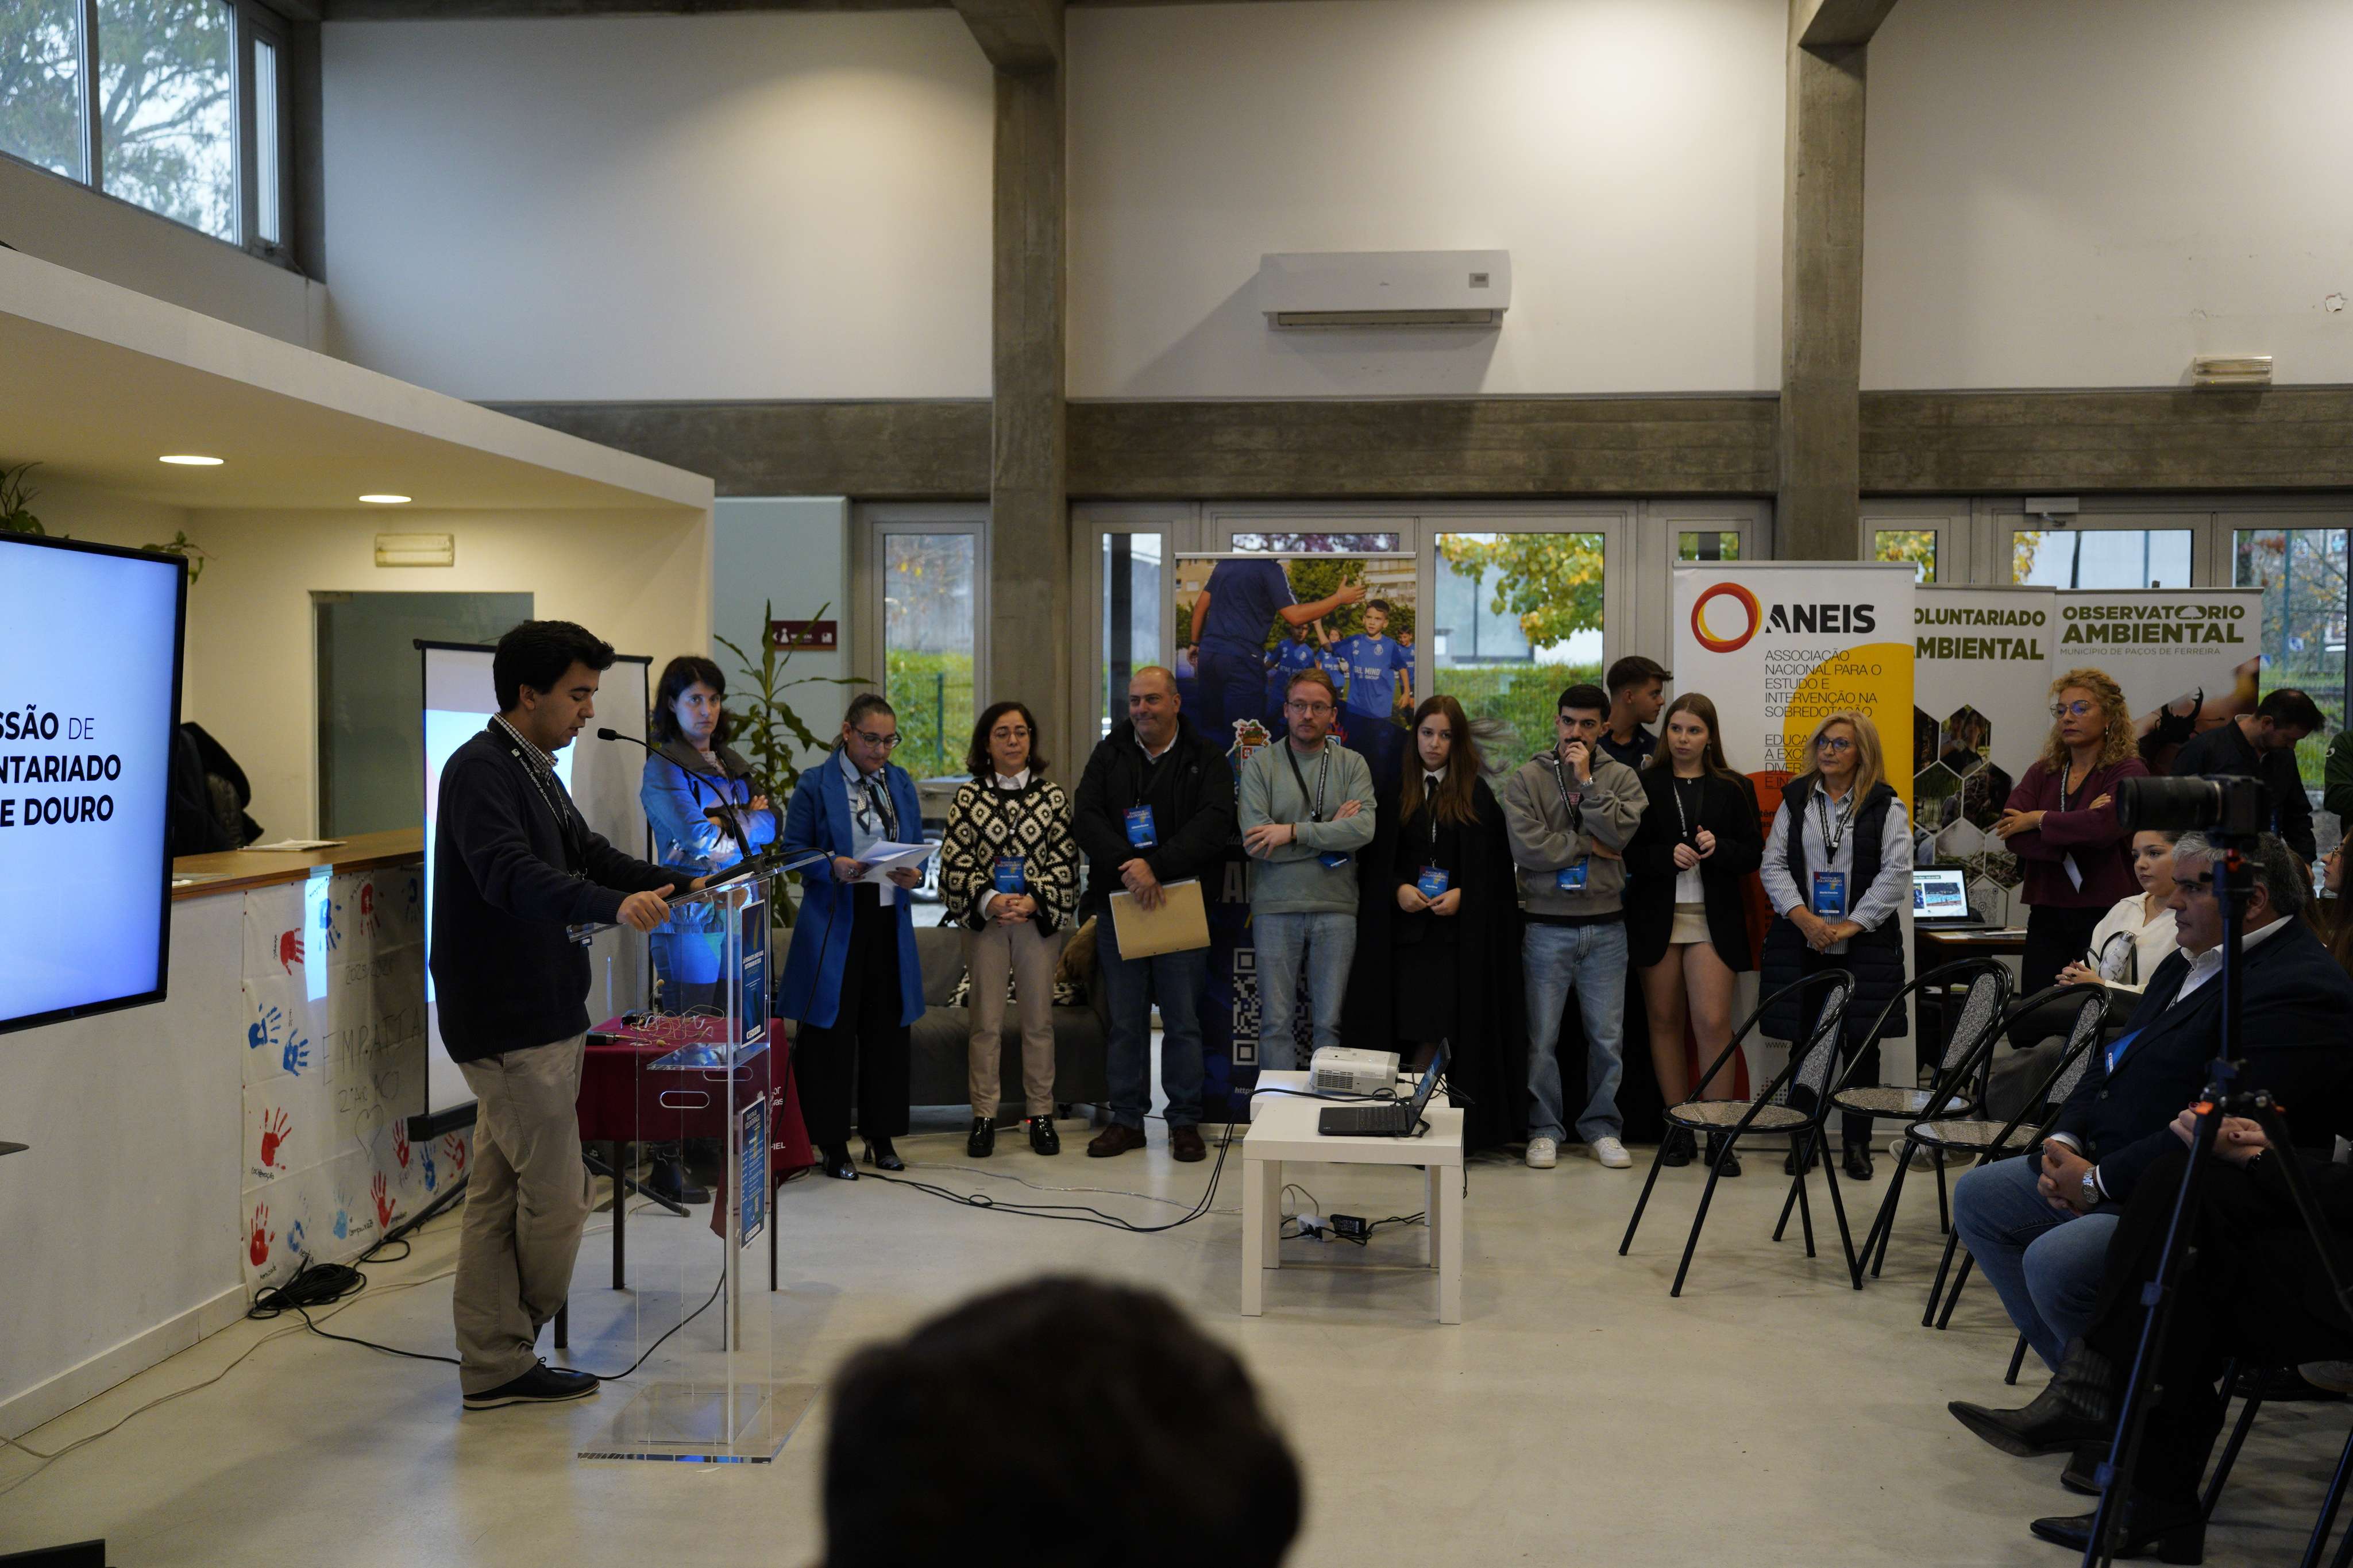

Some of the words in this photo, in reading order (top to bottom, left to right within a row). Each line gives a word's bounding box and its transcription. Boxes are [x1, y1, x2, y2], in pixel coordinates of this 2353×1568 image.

[1765, 604, 1876, 634] ANEIS
[2061, 623, 2244, 644] AMBIENTAL
[1765, 648, 1850, 664] ASSOCIAÇÃO
[1914, 636, 2045, 661] MBIENTAL
[2126, 648, 2157, 657] PAÇOS
[1765, 664, 1831, 675] NACIONAL
[1834, 664, 1868, 675] PARA
[1871, 664, 1882, 675] O
[1765, 678, 1818, 689] ESTUDO
[1822, 678, 1830, 689] E
[1765, 690, 1856, 706] INTERVENÇÃO
[1859, 693, 1878, 704] NA
[68, 717, 95, 740] DE
[1765, 748, 1774, 759] A
[1765, 777, 1773, 787] E
[24, 794, 114, 826] DOURO
